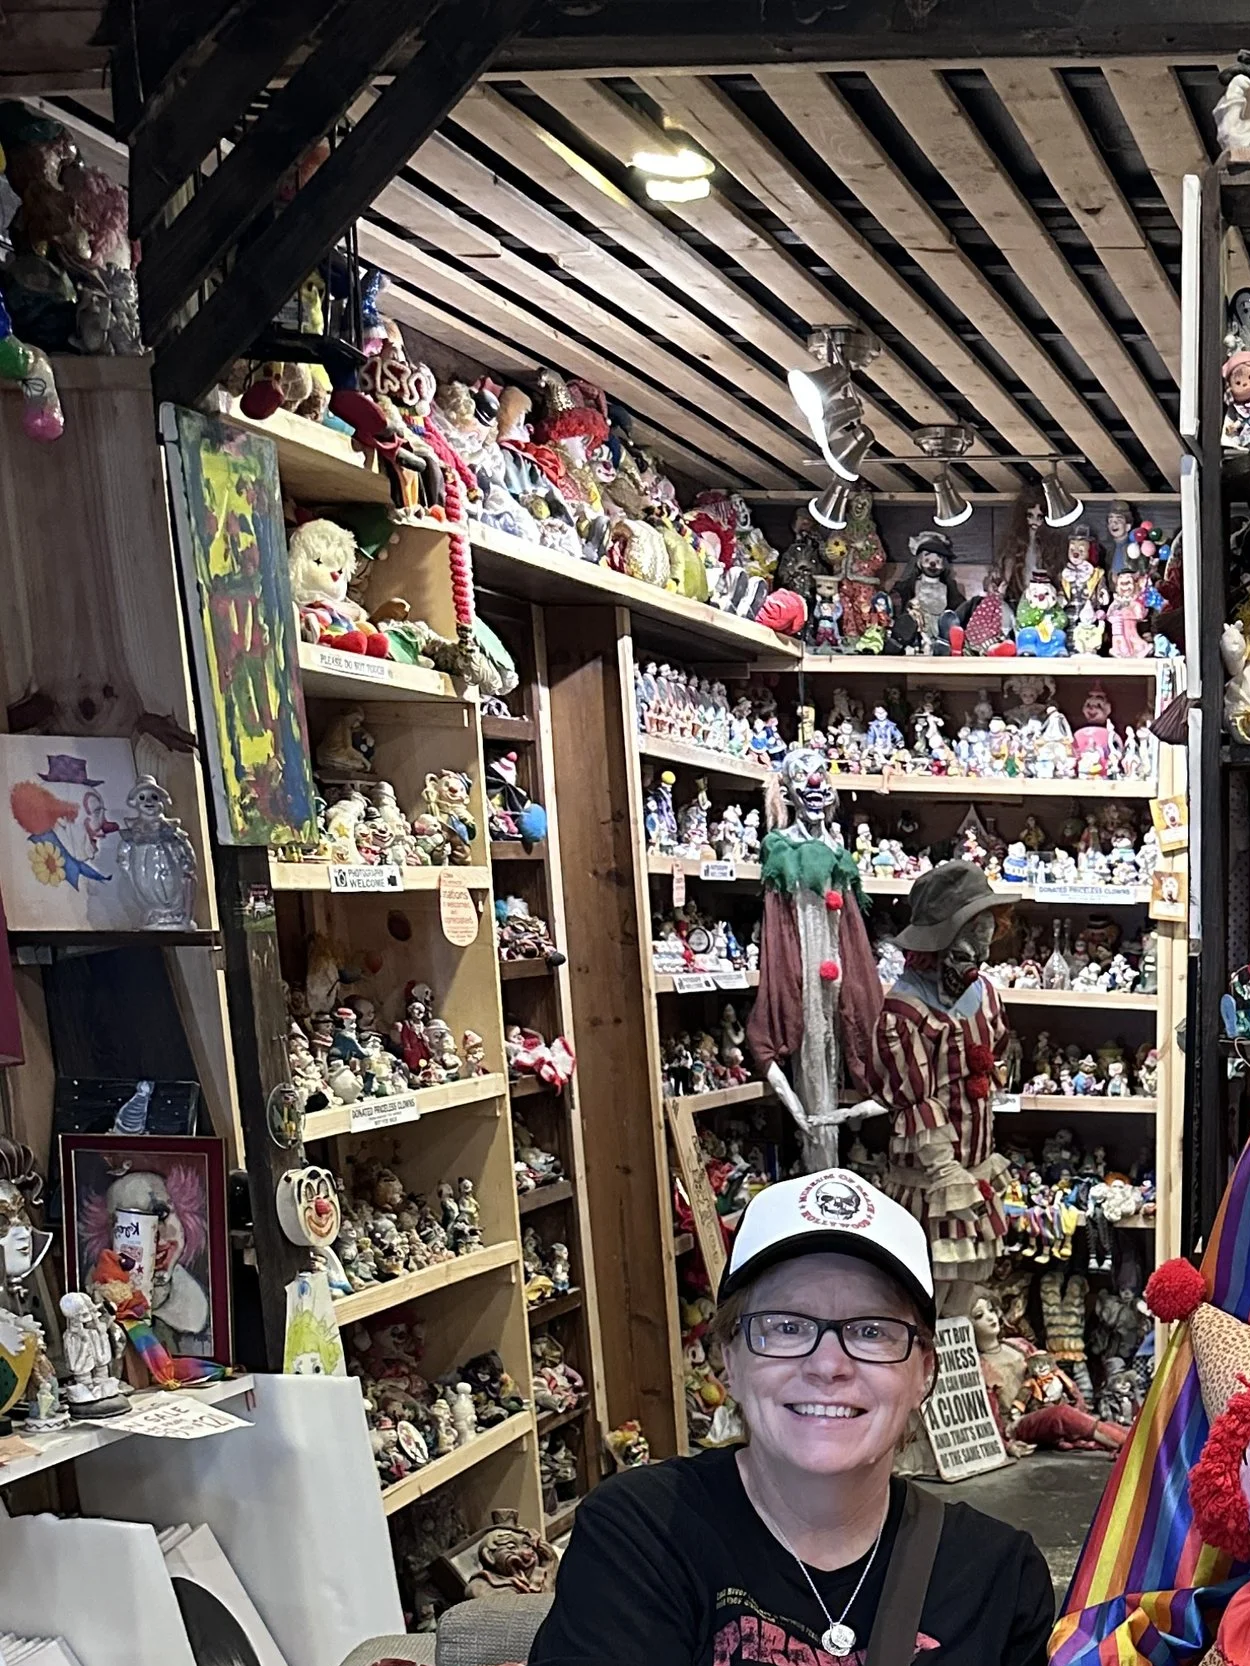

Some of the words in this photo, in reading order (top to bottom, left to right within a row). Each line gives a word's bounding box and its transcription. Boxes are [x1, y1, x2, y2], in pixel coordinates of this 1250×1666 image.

[319, 653, 343, 668] PLEASE
[350, 878, 385, 888] WELCOME
[952, 1324, 971, 1346] BUY
[945, 1375, 960, 1392] CAN
[958, 1371, 981, 1389] MARRY
[144, 1406, 190, 1423] SALE
[926, 1399, 940, 1431] A
[938, 1389, 989, 1428] CLOWN
[934, 1432, 951, 1450] AND
[950, 1426, 977, 1448] THAT'S
[976, 1421, 996, 1440] KIND
[939, 1452, 951, 1470] OF
[950, 1450, 963, 1467] THE
[961, 1445, 982, 1463] SAME
[979, 1440, 1002, 1459] THING
